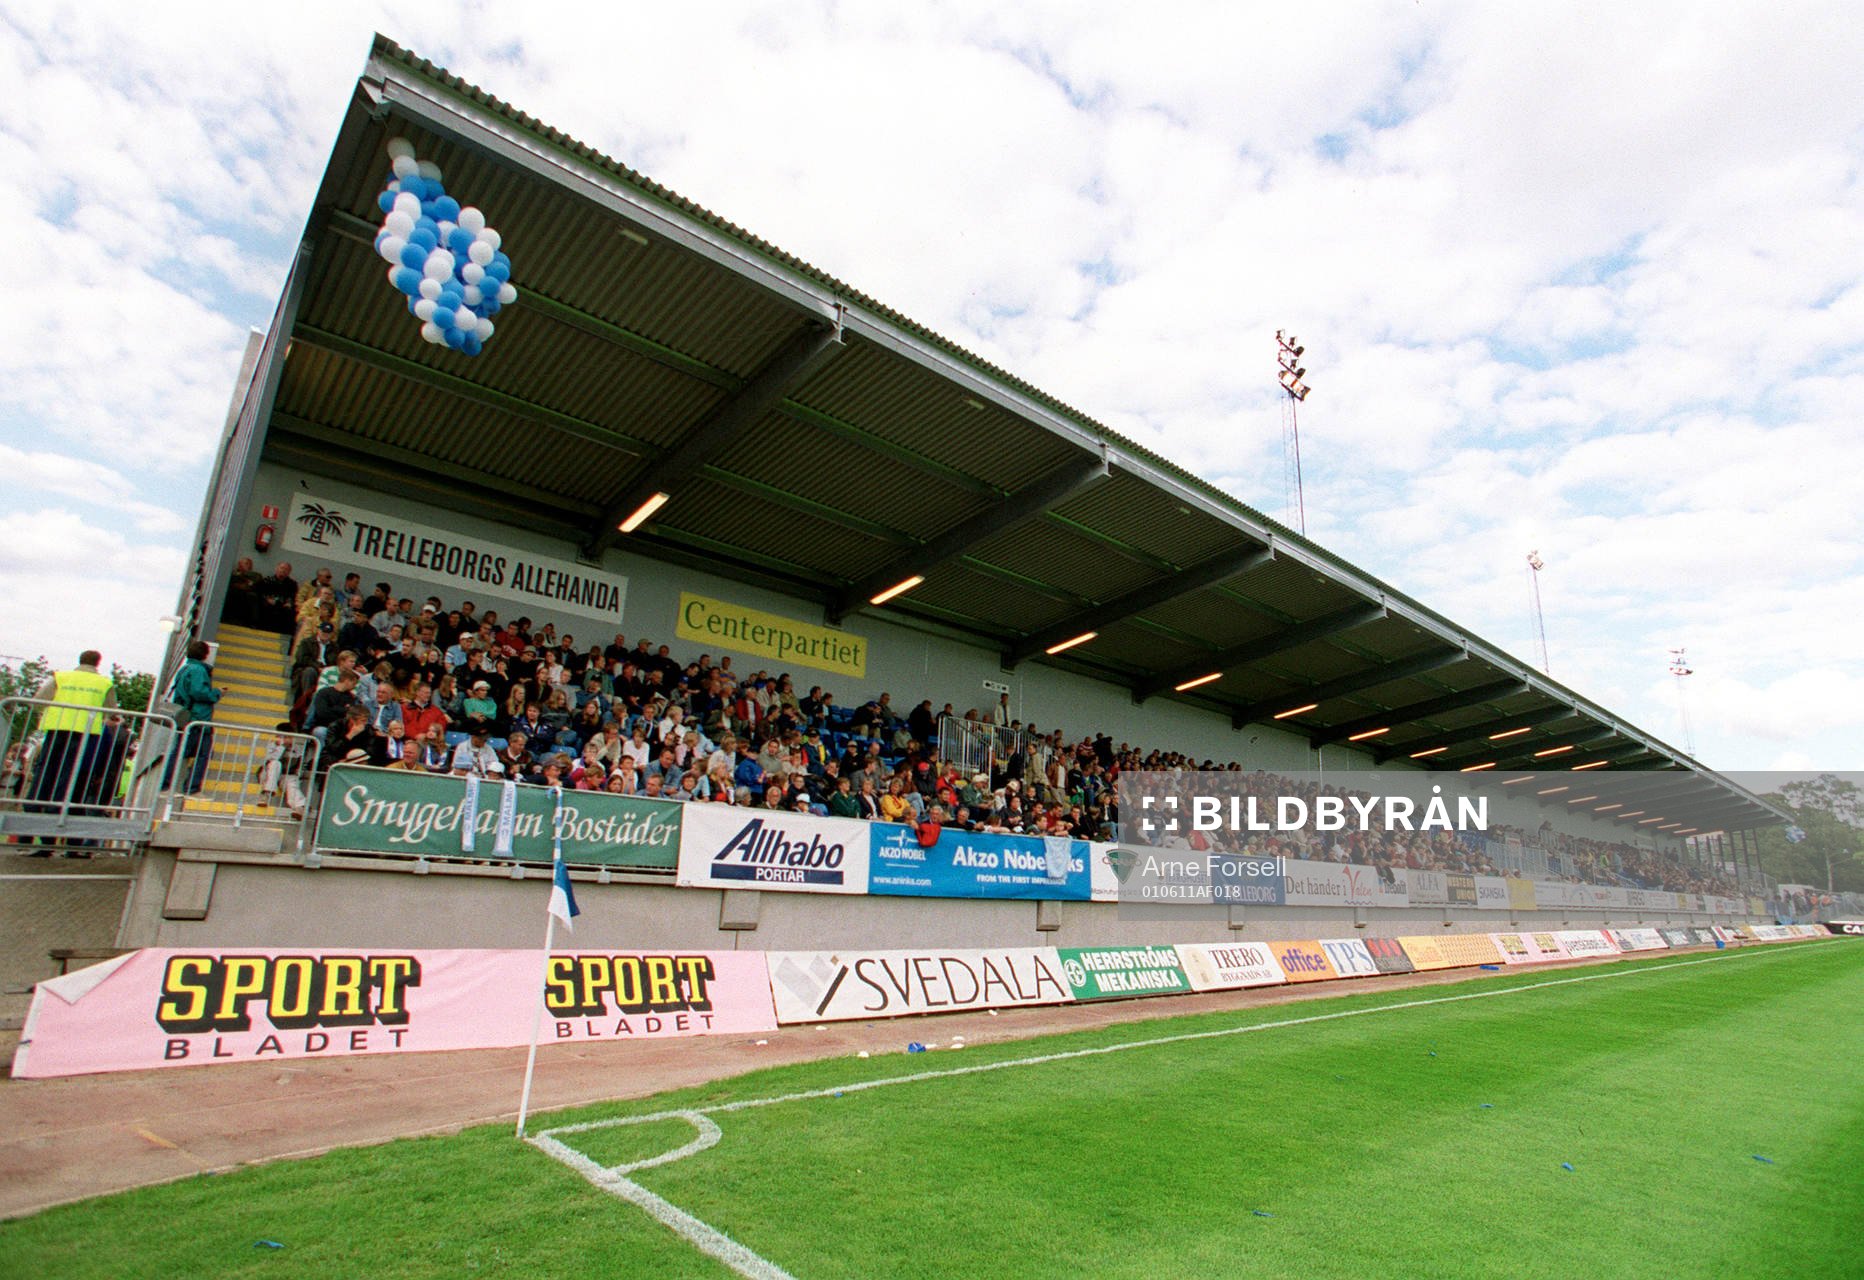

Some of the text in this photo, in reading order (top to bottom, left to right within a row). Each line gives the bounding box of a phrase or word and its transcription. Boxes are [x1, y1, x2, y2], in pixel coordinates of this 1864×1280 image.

[352, 521, 620, 614] TRELLEBORGS ALLEHANDA
[684, 601, 860, 668] Centerpartiet
[331, 784, 678, 847] Smygean Bostäder
[713, 818, 845, 869] Allhabo
[879, 847, 927, 861] AKZO NOBEL
[952, 845, 999, 868] Akzo
[1003, 848, 1047, 871] Nobe
[756, 867, 805, 883] PORTAR
[976, 874, 997, 883] FROM
[998, 875, 1010, 884] THE
[1011, 876, 1029, 885] FIRST
[1286, 876, 1305, 894] Det
[1307, 877, 1340, 896] händer
[1342, 879, 1347, 896] i
[1416, 873, 1439, 891] ALFA
[1479, 887, 1505, 900] SKANSKA
[1842, 925, 1864, 934] CA
[1080, 946, 1179, 969] HERRSTRÖMS
[1208, 947, 1265, 970] TREBO
[1281, 948, 1327, 973] office
[1322, 941, 1375, 974] TPS
[543, 955, 715, 1015] SPORT
[854, 955, 1066, 1012] SVEDALA
[1095, 967, 1182, 993] MEKANISKA
[156, 955, 421, 1035] SPORT
[556, 1014, 715, 1039] BLADET
[165, 1029, 408, 1060] BLADET
